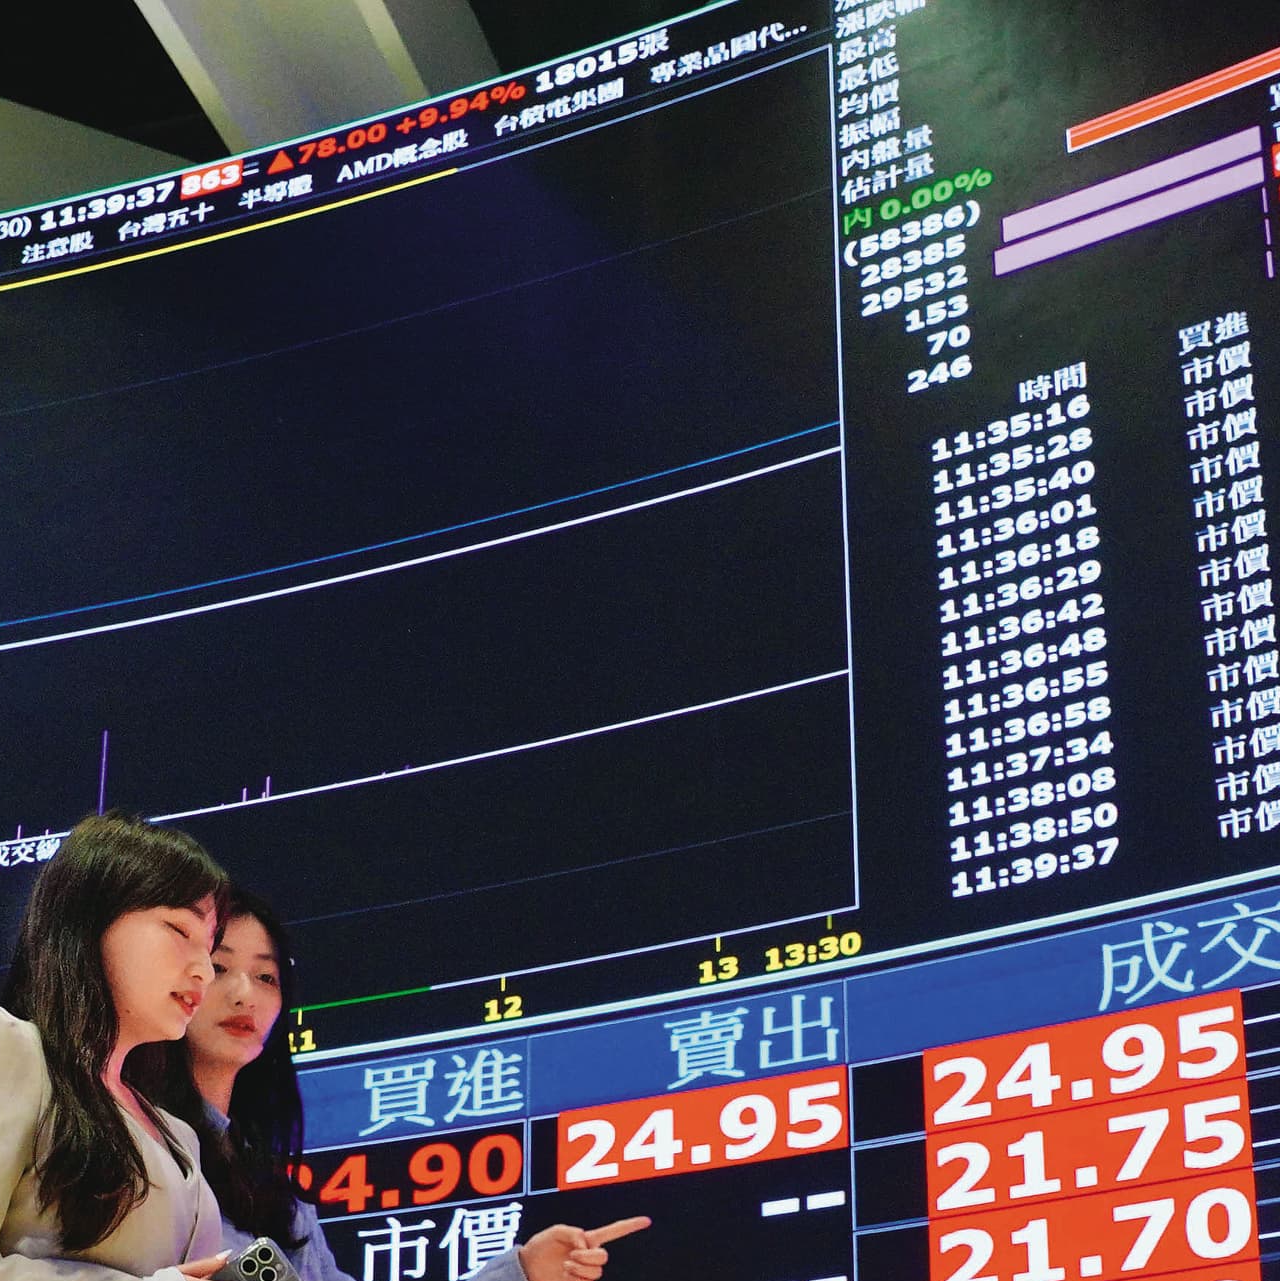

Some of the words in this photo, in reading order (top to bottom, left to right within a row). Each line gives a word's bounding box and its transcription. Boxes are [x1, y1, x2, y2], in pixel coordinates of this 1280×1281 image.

[40, 181, 175, 235] 11:39:37
[182, 165, 240, 195] 863
[299, 124, 386, 164] 78.00
[396, 82, 525, 133] +9.94%
[536, 29, 669, 92] 18015張
[880, 167, 993, 220] 0.00%
[844, 200, 980, 267] (58386)
[862, 265, 968, 318] 29532
[1179, 312, 1249, 356] 買進
[1181, 341, 1252, 384] 市價
[908, 355, 972, 393] 246
[1019, 362, 1087, 403] 時間
[932, 394, 1093, 463] 11:35:16
[934, 461, 1097, 529] 11:35:40
[1204, 614, 1276, 656] 市價
[946, 728, 1116, 792] 11:37:34
[951, 833, 1118, 897] 11:39:37
[700, 957, 738, 983] 13
[766, 932, 861, 971] 13:30
[485, 996, 522, 1021] 12
[664, 995, 839, 1089] 賣出
[934, 1006, 1238, 1124] 24.95
[359, 1049, 524, 1136] 買進
[566, 1082, 842, 1183] 24.95
[937, 1096, 1244, 1210] 21.75
[287, 1134, 522, 1212] 4.90
